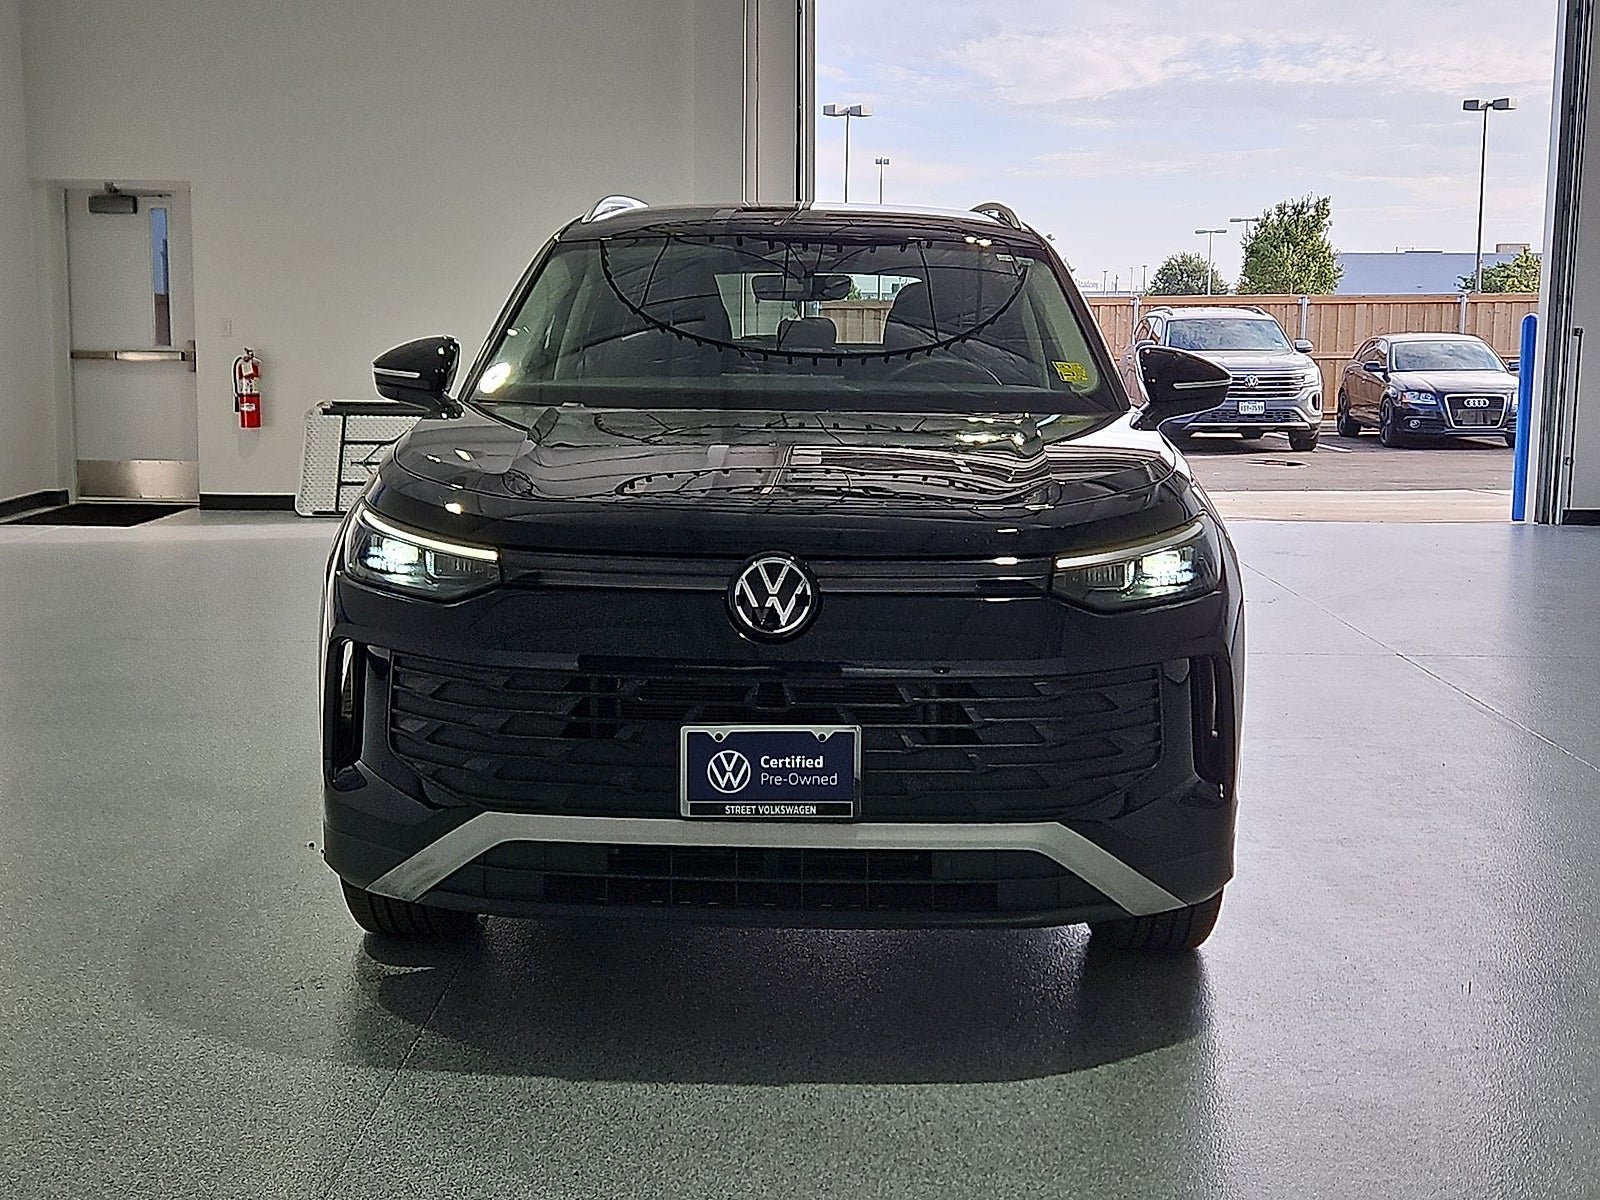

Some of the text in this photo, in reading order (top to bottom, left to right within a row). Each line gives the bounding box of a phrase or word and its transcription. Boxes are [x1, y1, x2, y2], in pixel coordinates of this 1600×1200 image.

[738, 559, 808, 629] VW
[760, 755, 824, 769] Certified
[709, 752, 749, 790] VW
[760, 772, 838, 786] Pre-Owned
[725, 805, 817, 815] STREET VOLKSWAGEN
